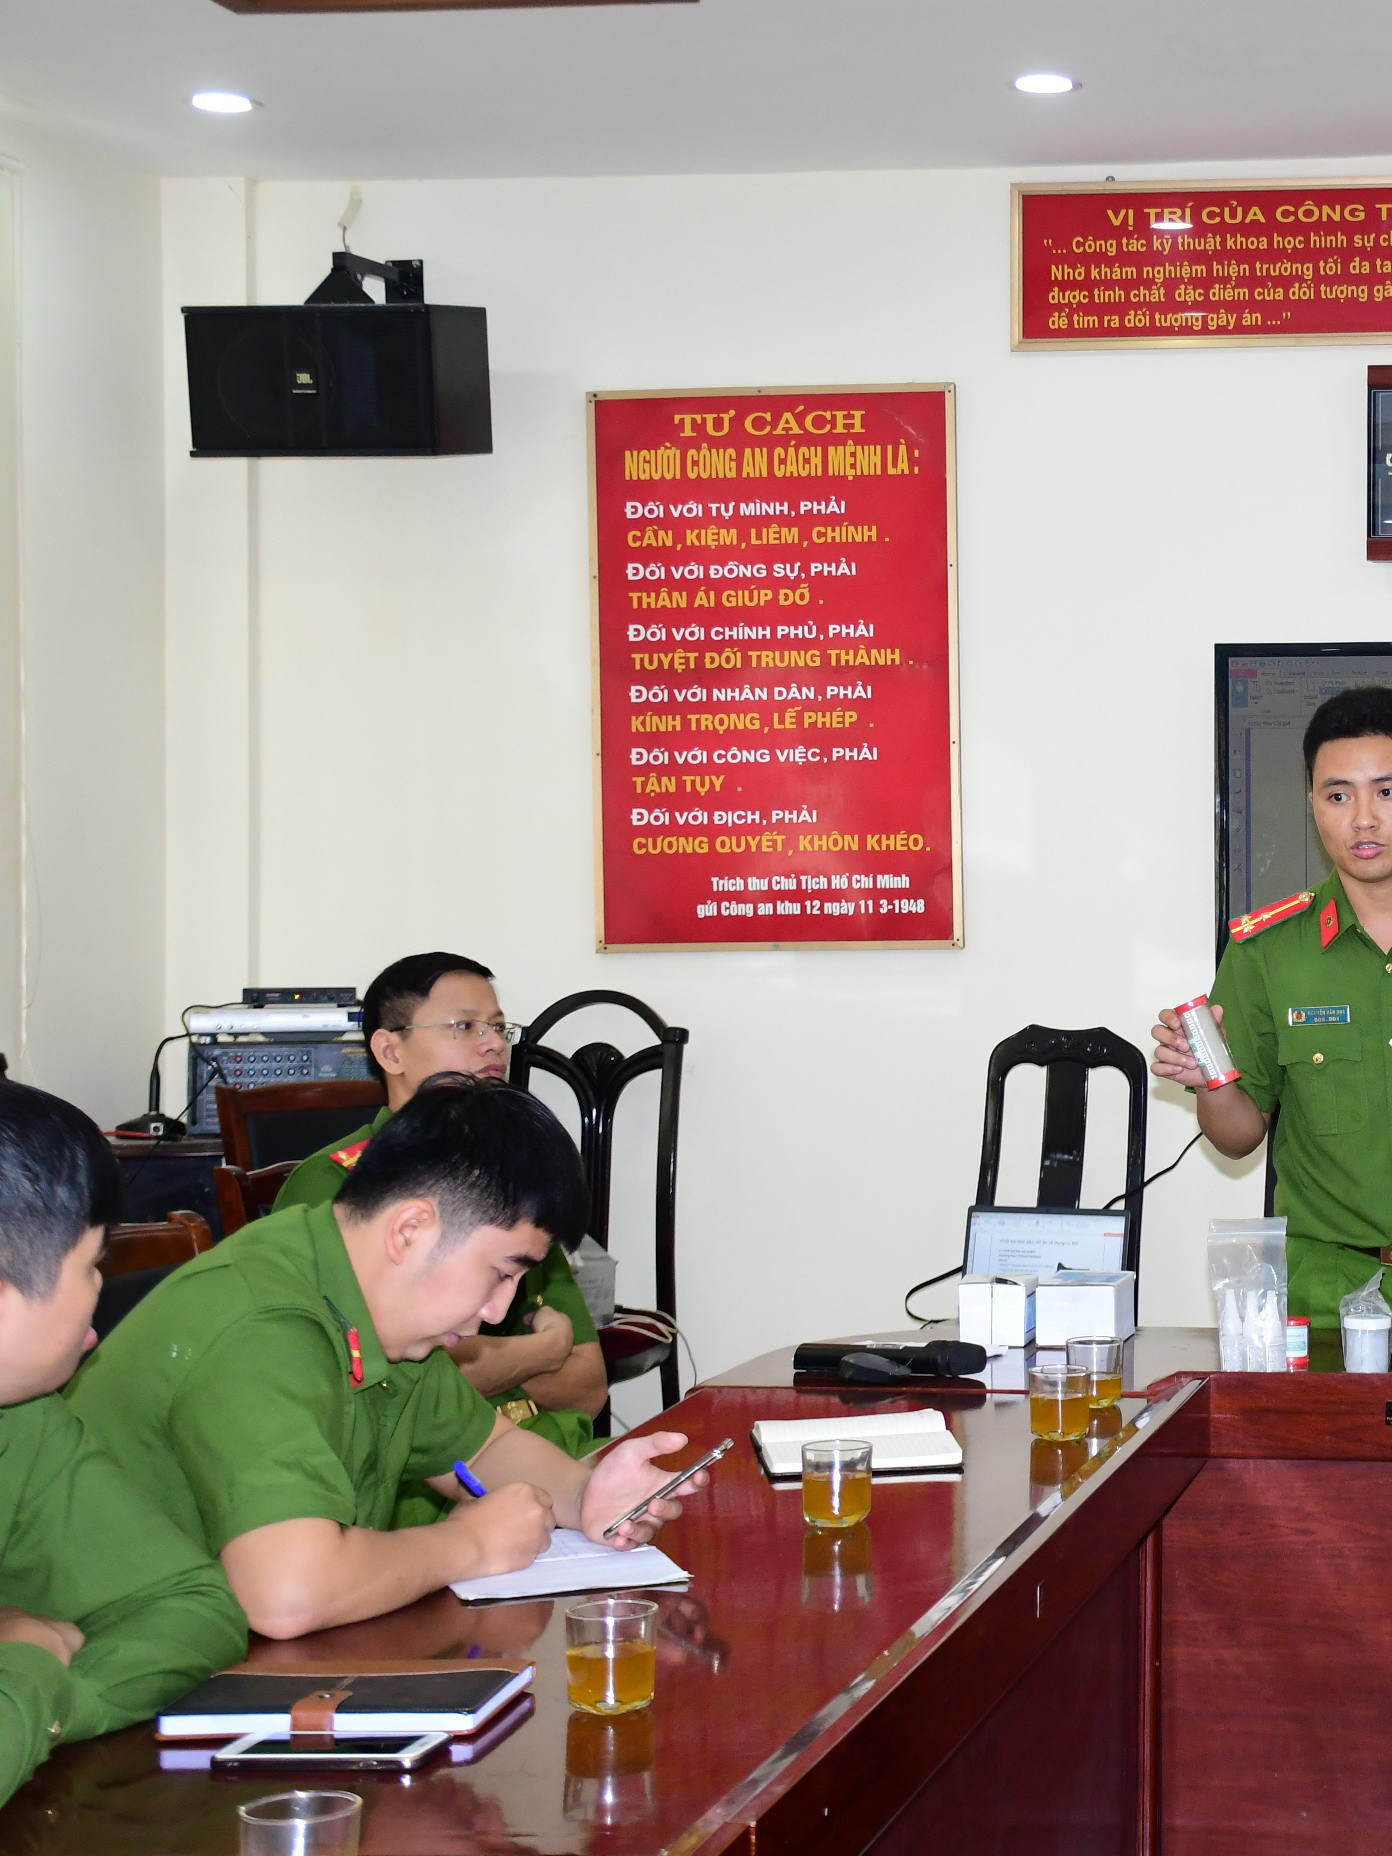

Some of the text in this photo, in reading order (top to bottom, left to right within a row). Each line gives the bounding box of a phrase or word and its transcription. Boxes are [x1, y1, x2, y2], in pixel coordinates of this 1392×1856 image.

[1106, 209, 1133, 230] VỊ
[1144, 202, 1193, 230] TRÍ
[1201, 200, 1265, 224] CỦA
[1275, 199, 1364, 223] CÔNG
[1072, 235, 1116, 256] Công
[1122, 234, 1146, 251] tác
[1153, 234, 1171, 254] kỹ
[1177, 233, 1221, 255] thuật
[1226, 232, 1267, 250] khoa
[1273, 232, 1304, 253] học
[1310, 231, 1346, 248] hình
[1354, 233, 1375, 251] sự
[674, 404, 865, 437] TƯ CÁCH
[624, 439, 909, 480] NGƯỜI CÔNG AN CÁCH MỆNH LÀ
[624, 495, 845, 520] ĐỐI VỚI TỰ MÌNH, PHẢI
[625, 557, 856, 580] ĐỐI VỚI ĐỒNG SỰ, PHẢI
[628, 583, 809, 609] THÂN ÁI GIÚP ĐỠ
[631, 644, 899, 673] TUYỆT ĐỐI TRUNG THÀNH
[628, 680, 871, 703] ĐỐI VỚI NHÂN DÂN, PHẢI
[631, 711, 680, 732] KÍNH
[803, 708, 858, 728] PHÉP
[632, 772, 724, 797] TẬN TỤY
[633, 830, 930, 856] CƯƠNG QUYẾT, KHÔN KHÉO.
[710, 872, 909, 893] Trích thư Chủ Tịch Hồ Chí Minh
[720, 900, 753, 917] Công
[757, 902, 773, 915] an
[776, 900, 800, 914] khu
[804, 899, 820, 914] 12
[823, 898, 855, 916] ngày
